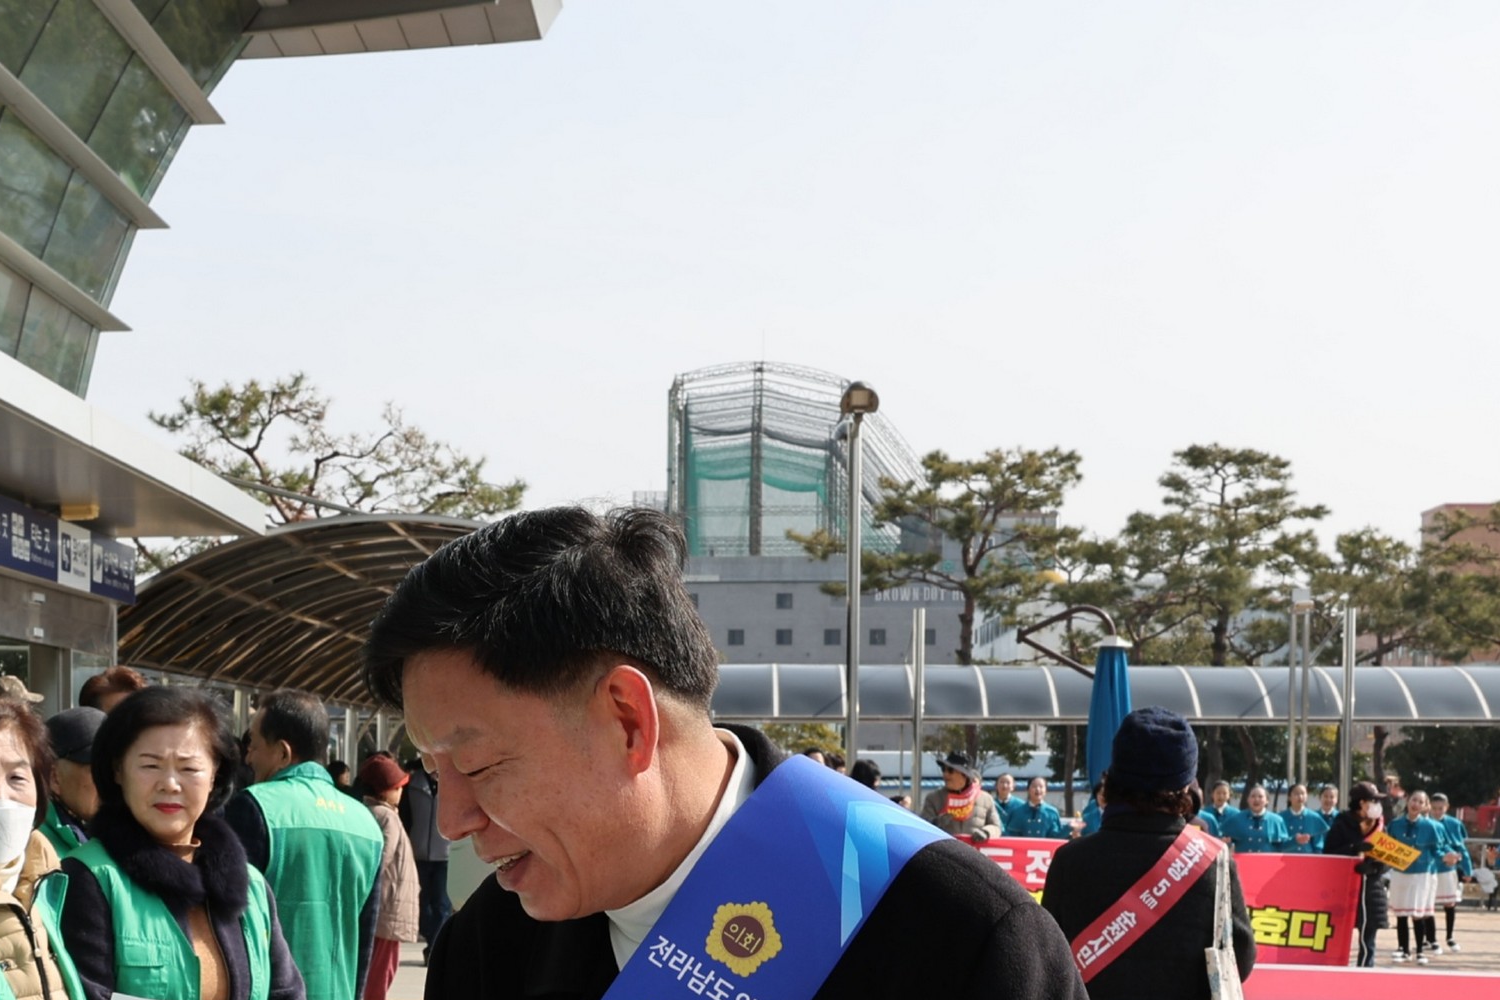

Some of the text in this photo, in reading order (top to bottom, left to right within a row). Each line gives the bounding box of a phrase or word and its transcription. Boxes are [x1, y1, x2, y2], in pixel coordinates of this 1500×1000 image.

[1139, 890, 1159, 910] km
[1153, 879, 1171, 897] 5
[724, 923, 762, 953] 의회
[1077, 910, 1137, 969] 순천시민
[1246, 905, 1332, 951] 효다
